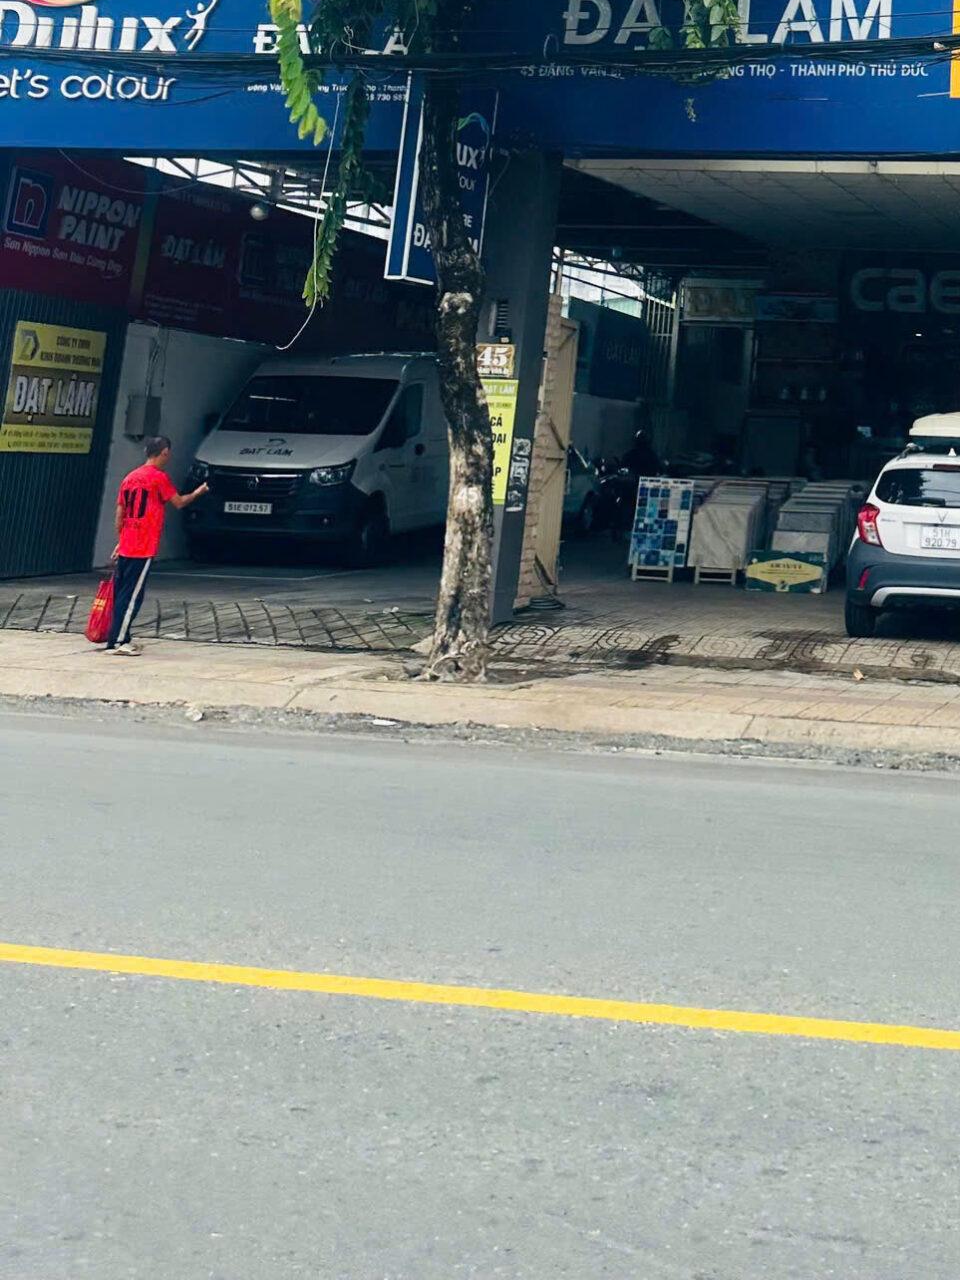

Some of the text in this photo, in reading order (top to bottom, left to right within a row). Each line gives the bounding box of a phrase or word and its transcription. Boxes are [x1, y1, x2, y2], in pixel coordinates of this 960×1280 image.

[0, 0, 182, 53] Dulux
[0, 68, 177, 101] et's colour
[749, 64, 776, 79] THỌ
[790, 60, 836, 77] THÀNH
[56, 185, 142, 228] NIPPON
[58, 215, 126, 252] PAINT
[477, 346, 509, 367] 45
[54, 373, 96, 417] LÂM
